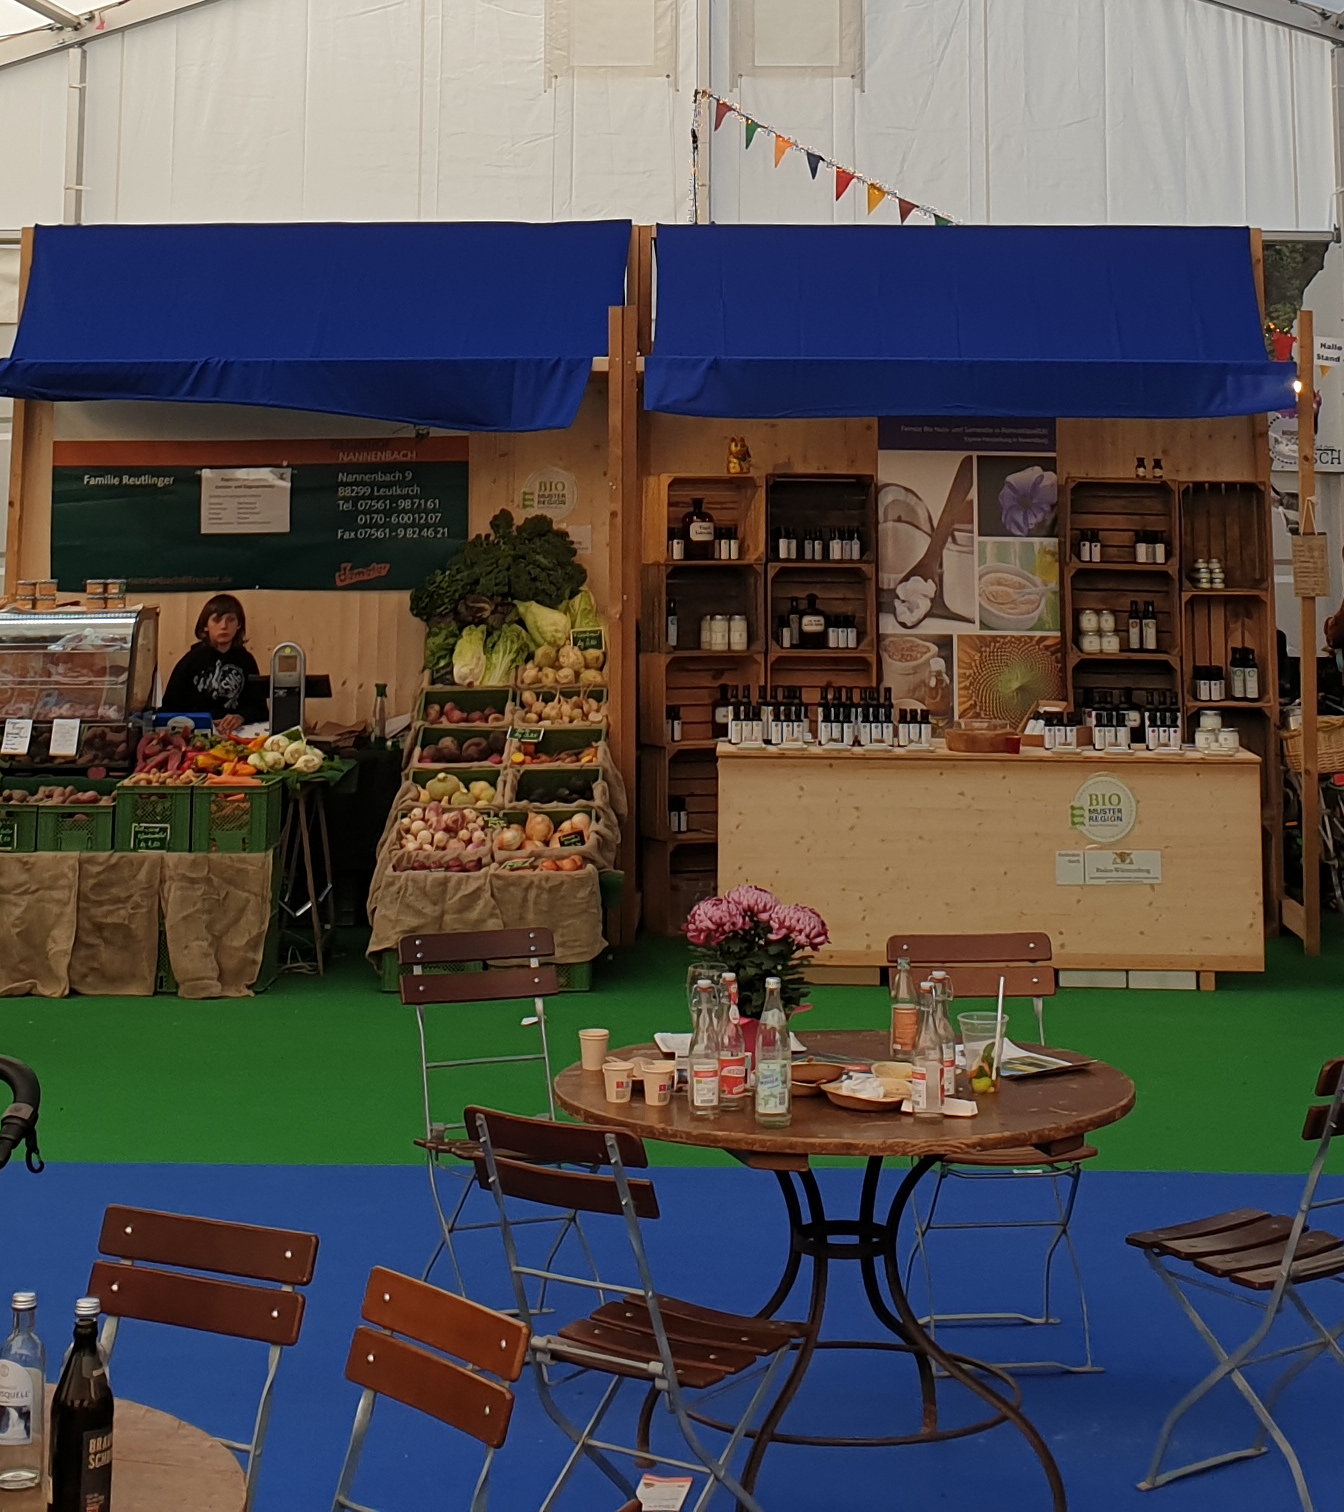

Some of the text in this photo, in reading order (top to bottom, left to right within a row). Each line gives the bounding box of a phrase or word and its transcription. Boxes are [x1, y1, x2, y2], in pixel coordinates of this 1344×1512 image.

[1320, 342, 1343, 351] Halle
[1316, 353, 1341, 363] Stand
[338, 450, 417, 463] NANNENBACH
[83, 474, 175, 488] Familie Reutlinger
[337, 470, 413, 483] Nannenbach 9
[337, 484, 421, 497] 88299 Leutkirch
[337, 528, 355, 539] Fax
[1088, 793, 1122, 807] BIO
